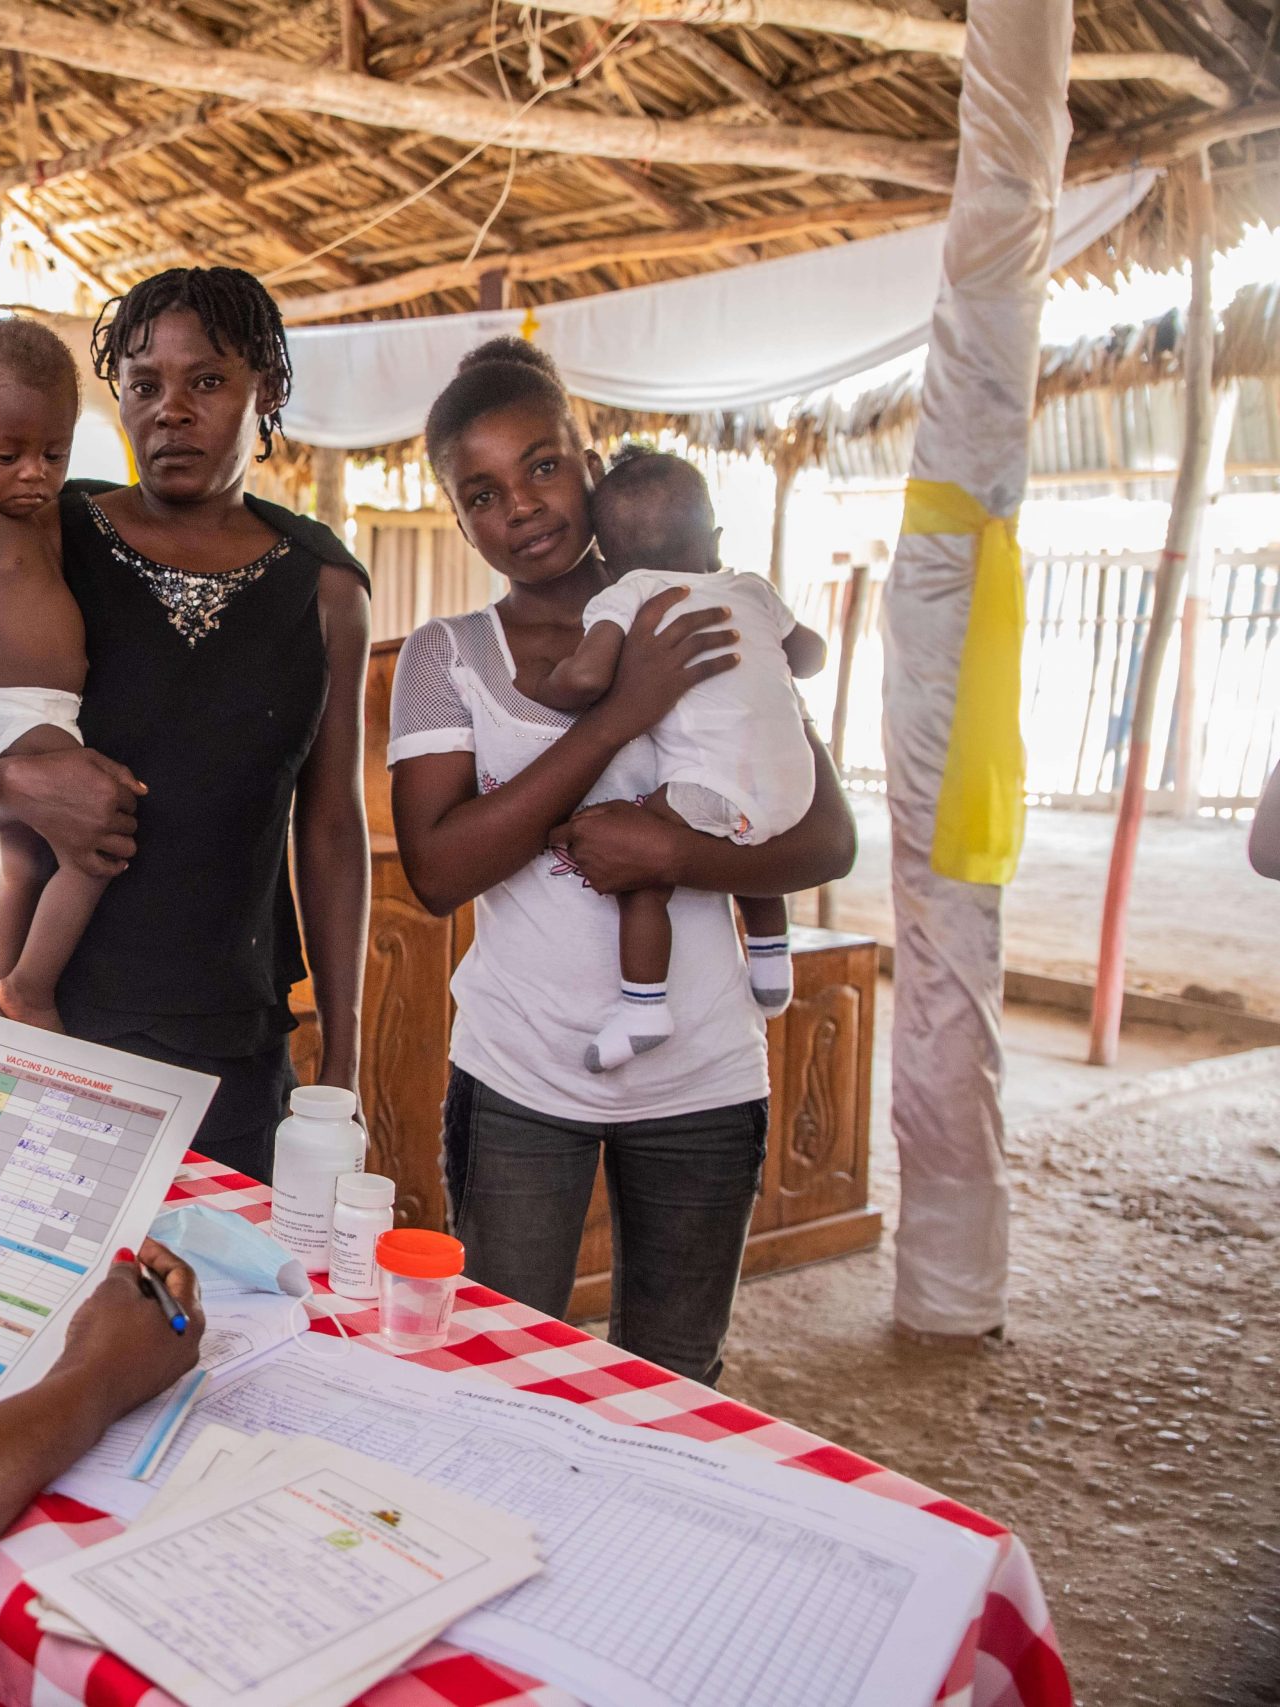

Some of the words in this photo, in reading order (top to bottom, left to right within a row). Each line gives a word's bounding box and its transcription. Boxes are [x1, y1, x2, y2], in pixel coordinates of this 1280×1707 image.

[6, 1055, 42, 1073] VACCINS
[43, 1066, 56, 1076] DU
[57, 1070, 113, 1093] PROGRAMME
[454, 1389, 505, 1405] CAHIER
[506, 1400, 524, 1410] DE
[527, 1404, 575, 1426] POSTE
[576, 1424, 596, 1437] DE
[598, 1434, 730, 1471] RASSEMBLEMENT
